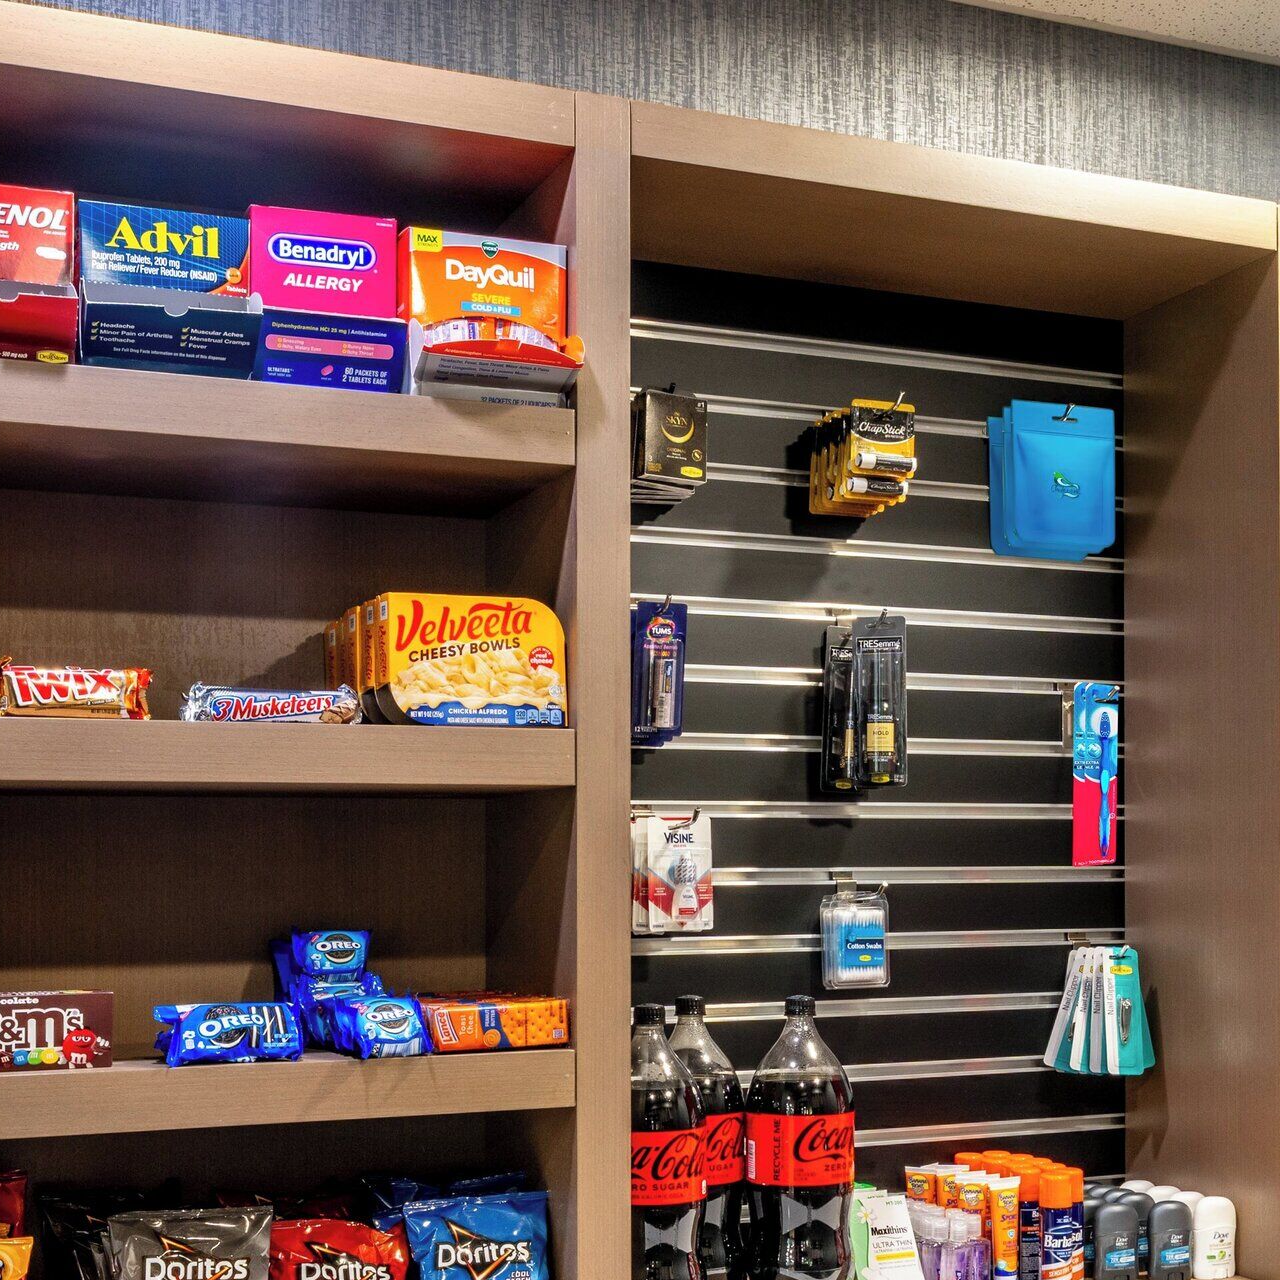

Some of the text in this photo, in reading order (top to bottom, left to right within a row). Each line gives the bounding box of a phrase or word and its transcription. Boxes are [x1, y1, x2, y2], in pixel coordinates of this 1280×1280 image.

[105, 217, 220, 258] Advil
[417, 234, 438, 243] MAX
[279, 239, 364, 268] Benadryl
[153, 256, 180, 269] 200 mg
[160, 267, 188, 279] Reducer
[445, 258, 535, 289] DayQuil
[283, 273, 363, 293] ALLERGY
[471, 292, 511, 306] SEVERE
[471, 304, 492, 312] COLD
[190, 328, 221, 337] Muscular
[189, 336, 250, 347] Menstrual Cramps
[348, 376, 372, 384] TABLETS
[354, 369, 379, 377] PACKETS
[859, 421, 906, 436] ChapStick
[395, 599, 533, 652] Velveeta
[651, 627, 672, 635] TUMS
[408, 637, 520, 663] CHEESY BOWLS
[12, 669, 120, 706] TWIX
[213, 694, 334, 722] 3 Musketeers
[664, 832, 694, 844] VISINE
[316, 938, 361, 952] OREO
[847, 942, 882, 950] Cotton Swabs
[1062, 998, 1072, 1012] Nail
[366, 1003, 414, 1024] OREO
[199, 1012, 264, 1037] OREO
[438, 1011, 453, 1043] Lance
[773, 1118, 782, 1182] RECYCLE ME
[824, 1163, 847, 1172] ZERO
[651, 1183, 690, 1192] SUGAR
[871, 1224, 908, 1237] Maxithins
[1213, 1231, 1229, 1239] Dove
[872, 1238, 913, 1249] ULTRA THIN
[438, 1242, 530, 1268] Doritos
